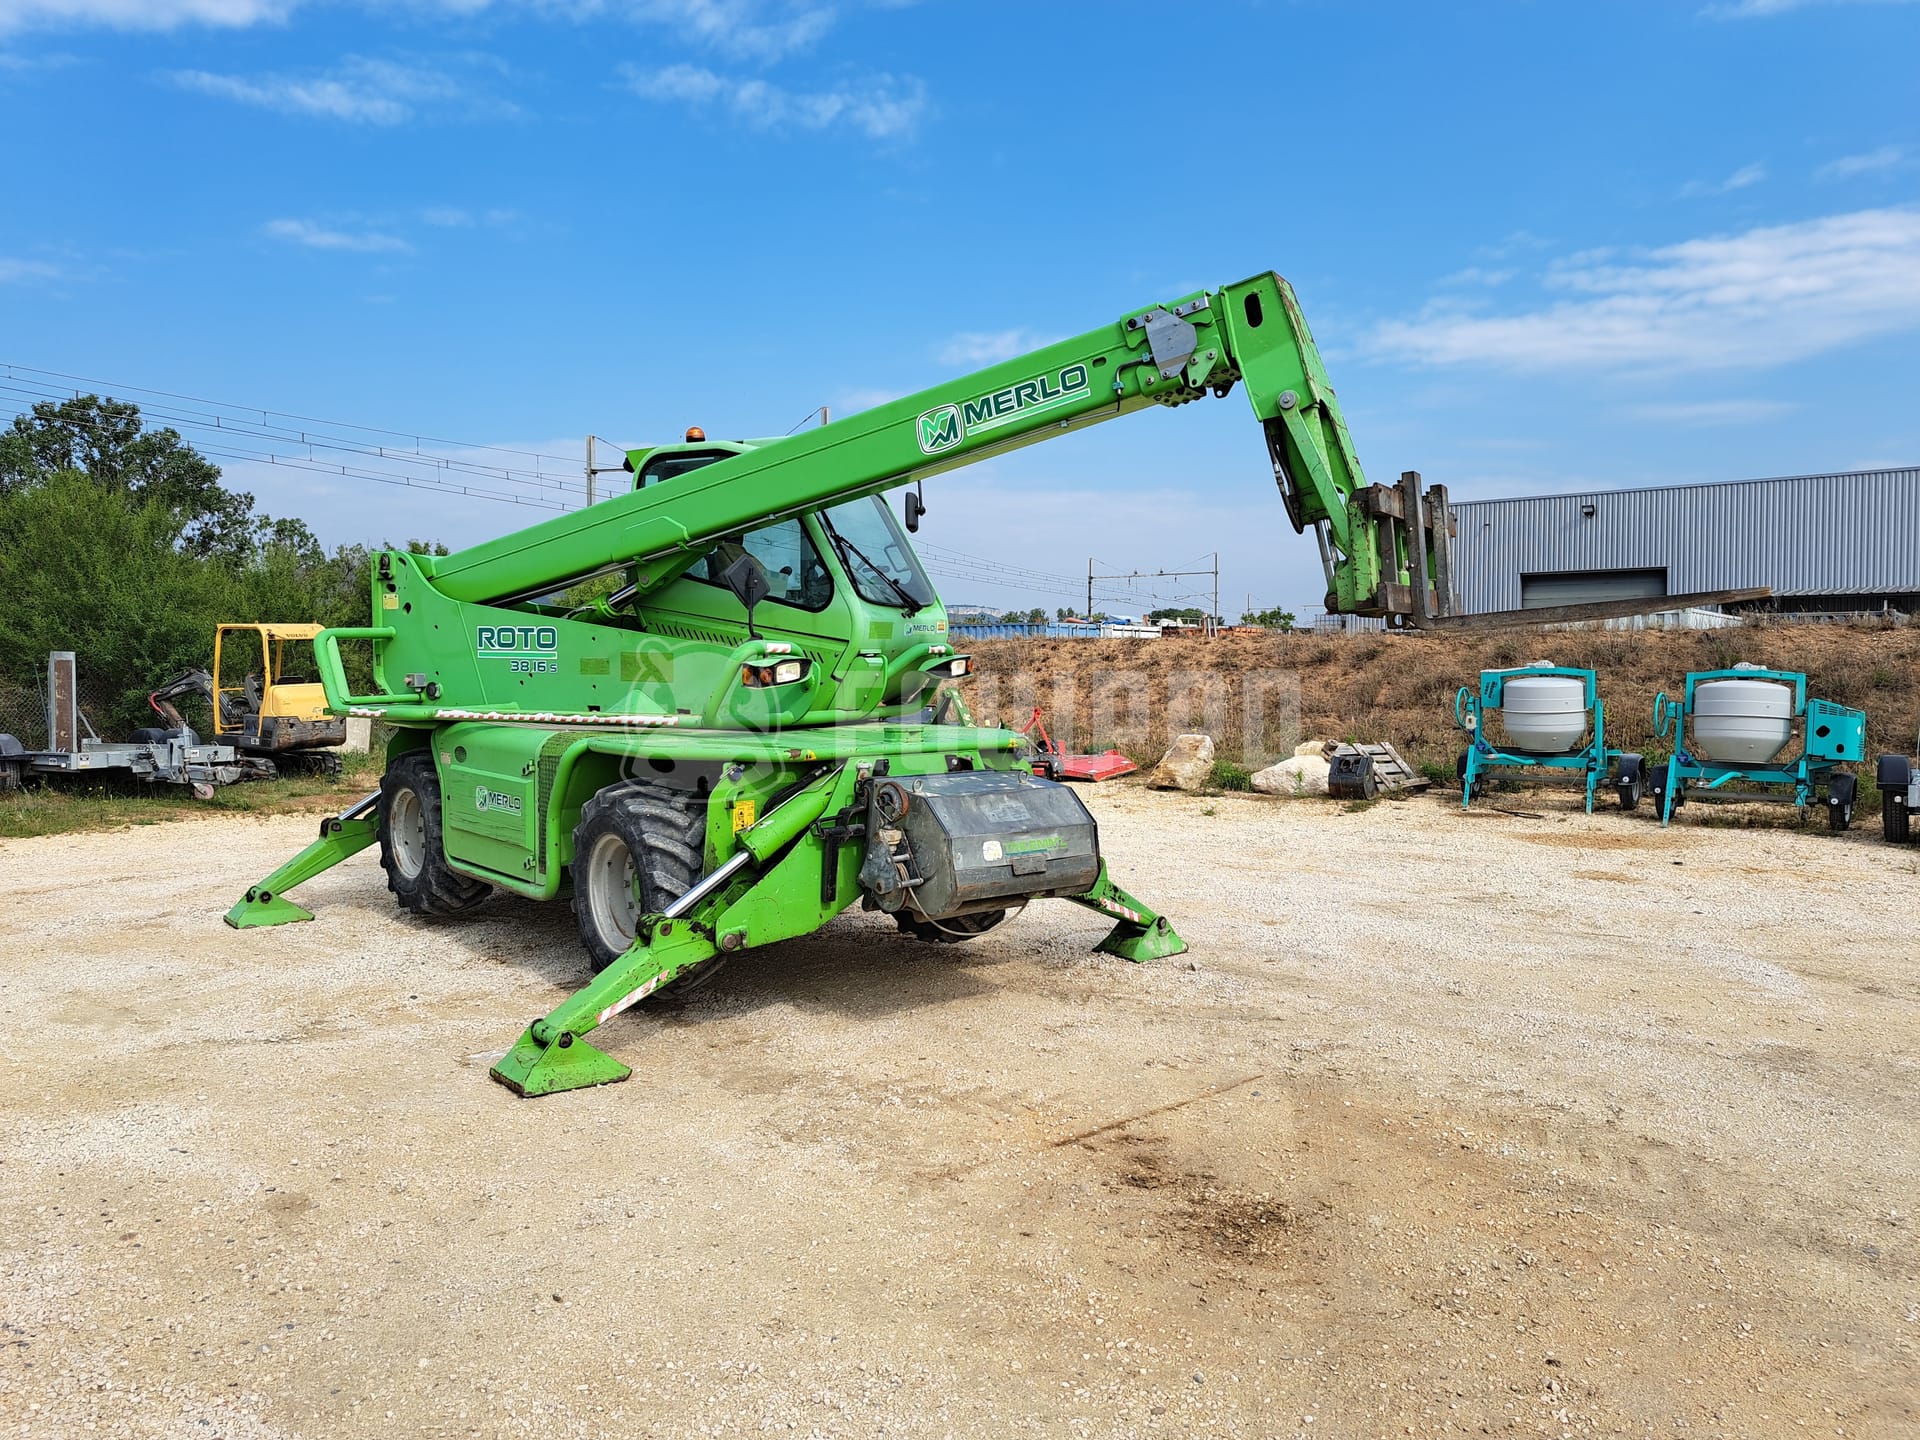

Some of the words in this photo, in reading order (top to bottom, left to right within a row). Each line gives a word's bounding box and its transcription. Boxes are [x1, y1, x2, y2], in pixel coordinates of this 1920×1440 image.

[963, 364, 1088, 426] MERLO
[477, 626, 557, 650] ROTO
[489, 791, 521, 809] MERLO
